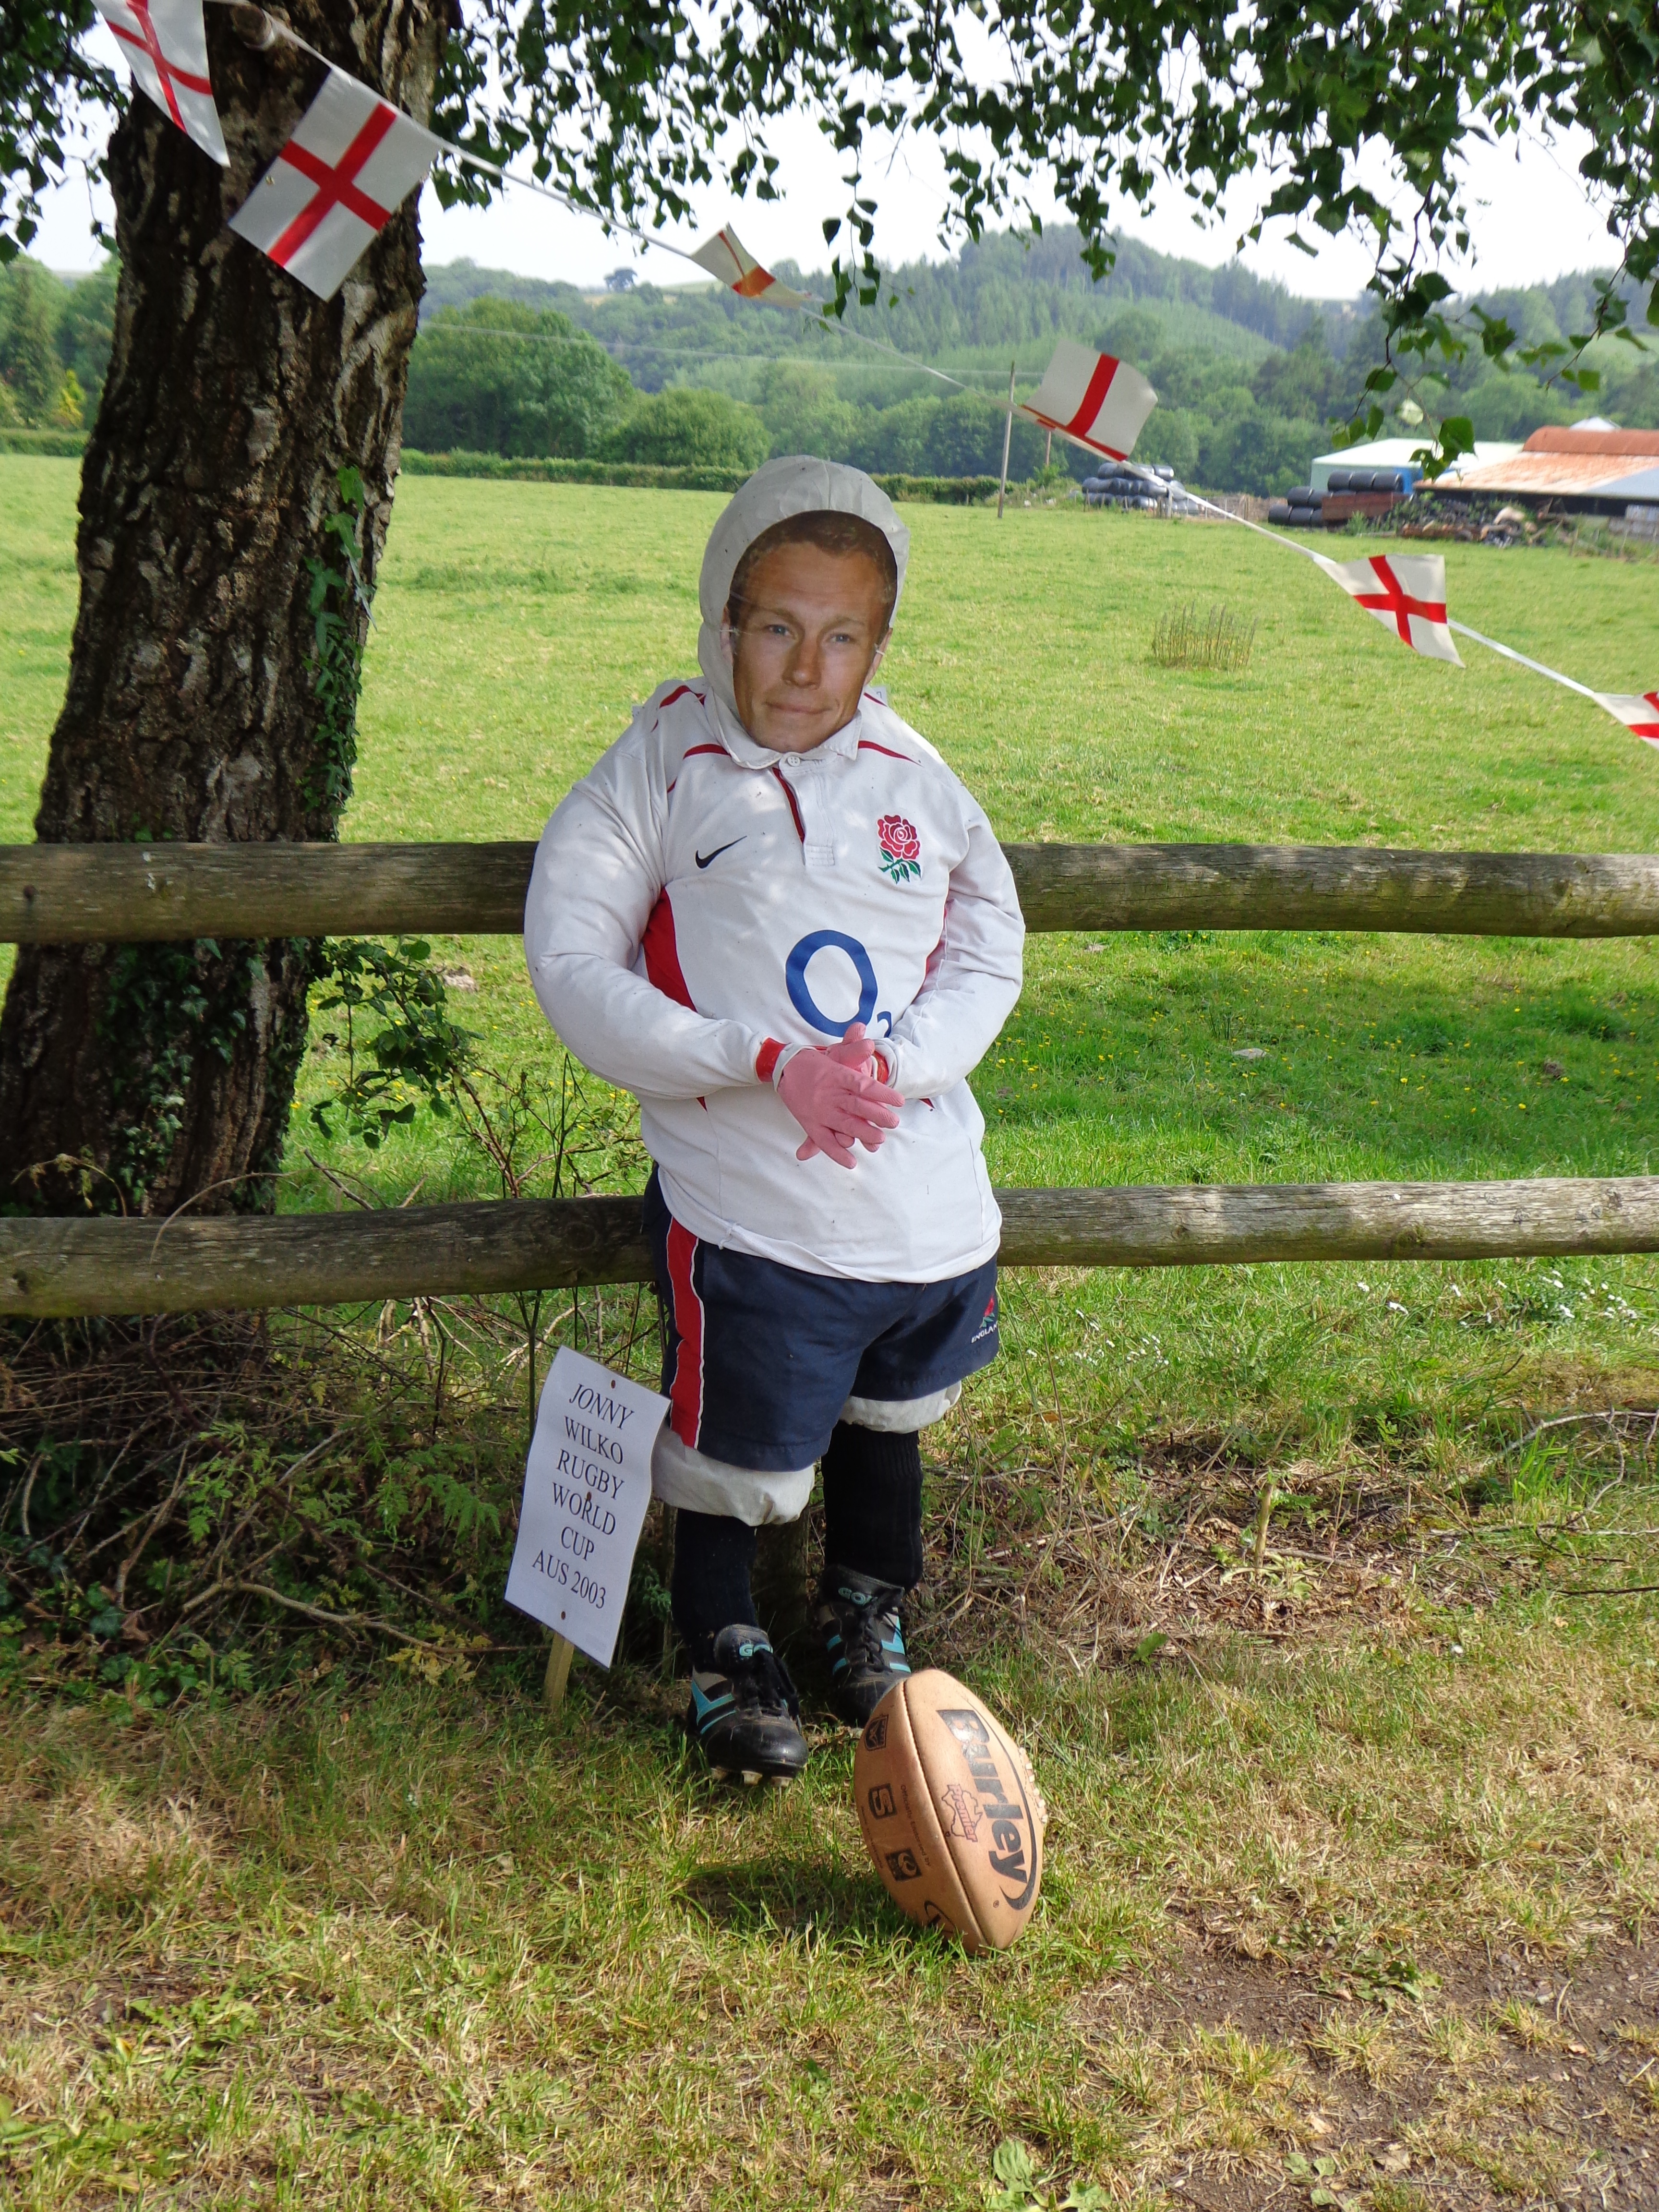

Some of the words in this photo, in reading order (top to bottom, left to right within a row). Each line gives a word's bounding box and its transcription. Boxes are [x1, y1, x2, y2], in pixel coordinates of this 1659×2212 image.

[971, 1321, 998, 1344] ENGLAN
[569, 1383, 635, 1430] JONNY
[565, 1416, 623, 1464] WILKO
[555, 1448, 625, 1501] RUGBY
[553, 1482, 616, 1535] WORLD
[561, 1527, 595, 1562] CUP
[532, 1549, 569, 1585] AUS
[571, 1571, 606, 1609] 2003
[937, 1709, 1028, 1885] Burley
[947, 1783, 978, 1842] Premier
